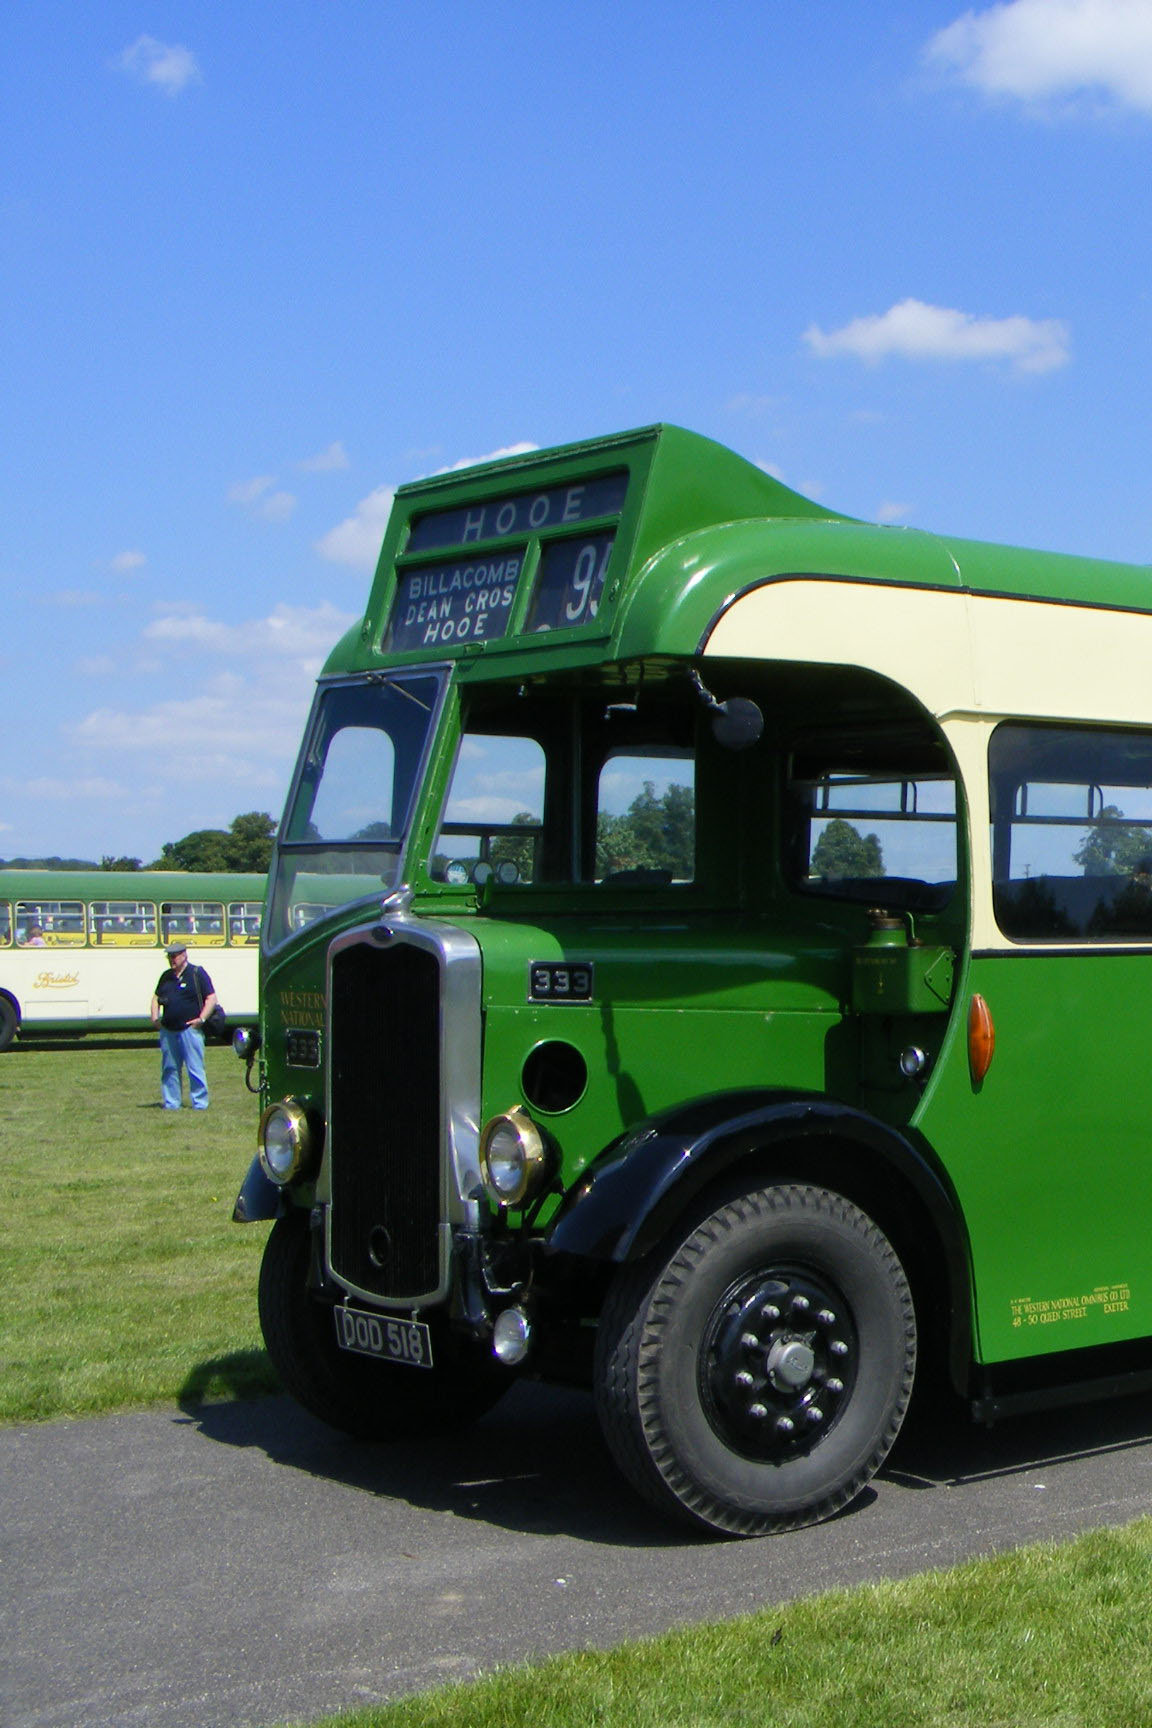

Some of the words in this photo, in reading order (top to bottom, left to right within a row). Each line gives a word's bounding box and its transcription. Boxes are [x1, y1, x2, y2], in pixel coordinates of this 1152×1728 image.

[462, 486, 585, 542] HOOE
[405, 596, 453, 625] DEAN
[423, 613, 488, 644] HOOE
[535, 969, 589, 992] 333
[280, 991, 327, 1008] WESTERN
[1104, 1300, 1129, 1314] EXETER
[342, 1312, 383, 1351] DOD
[388, 1323, 423, 1361] 518
